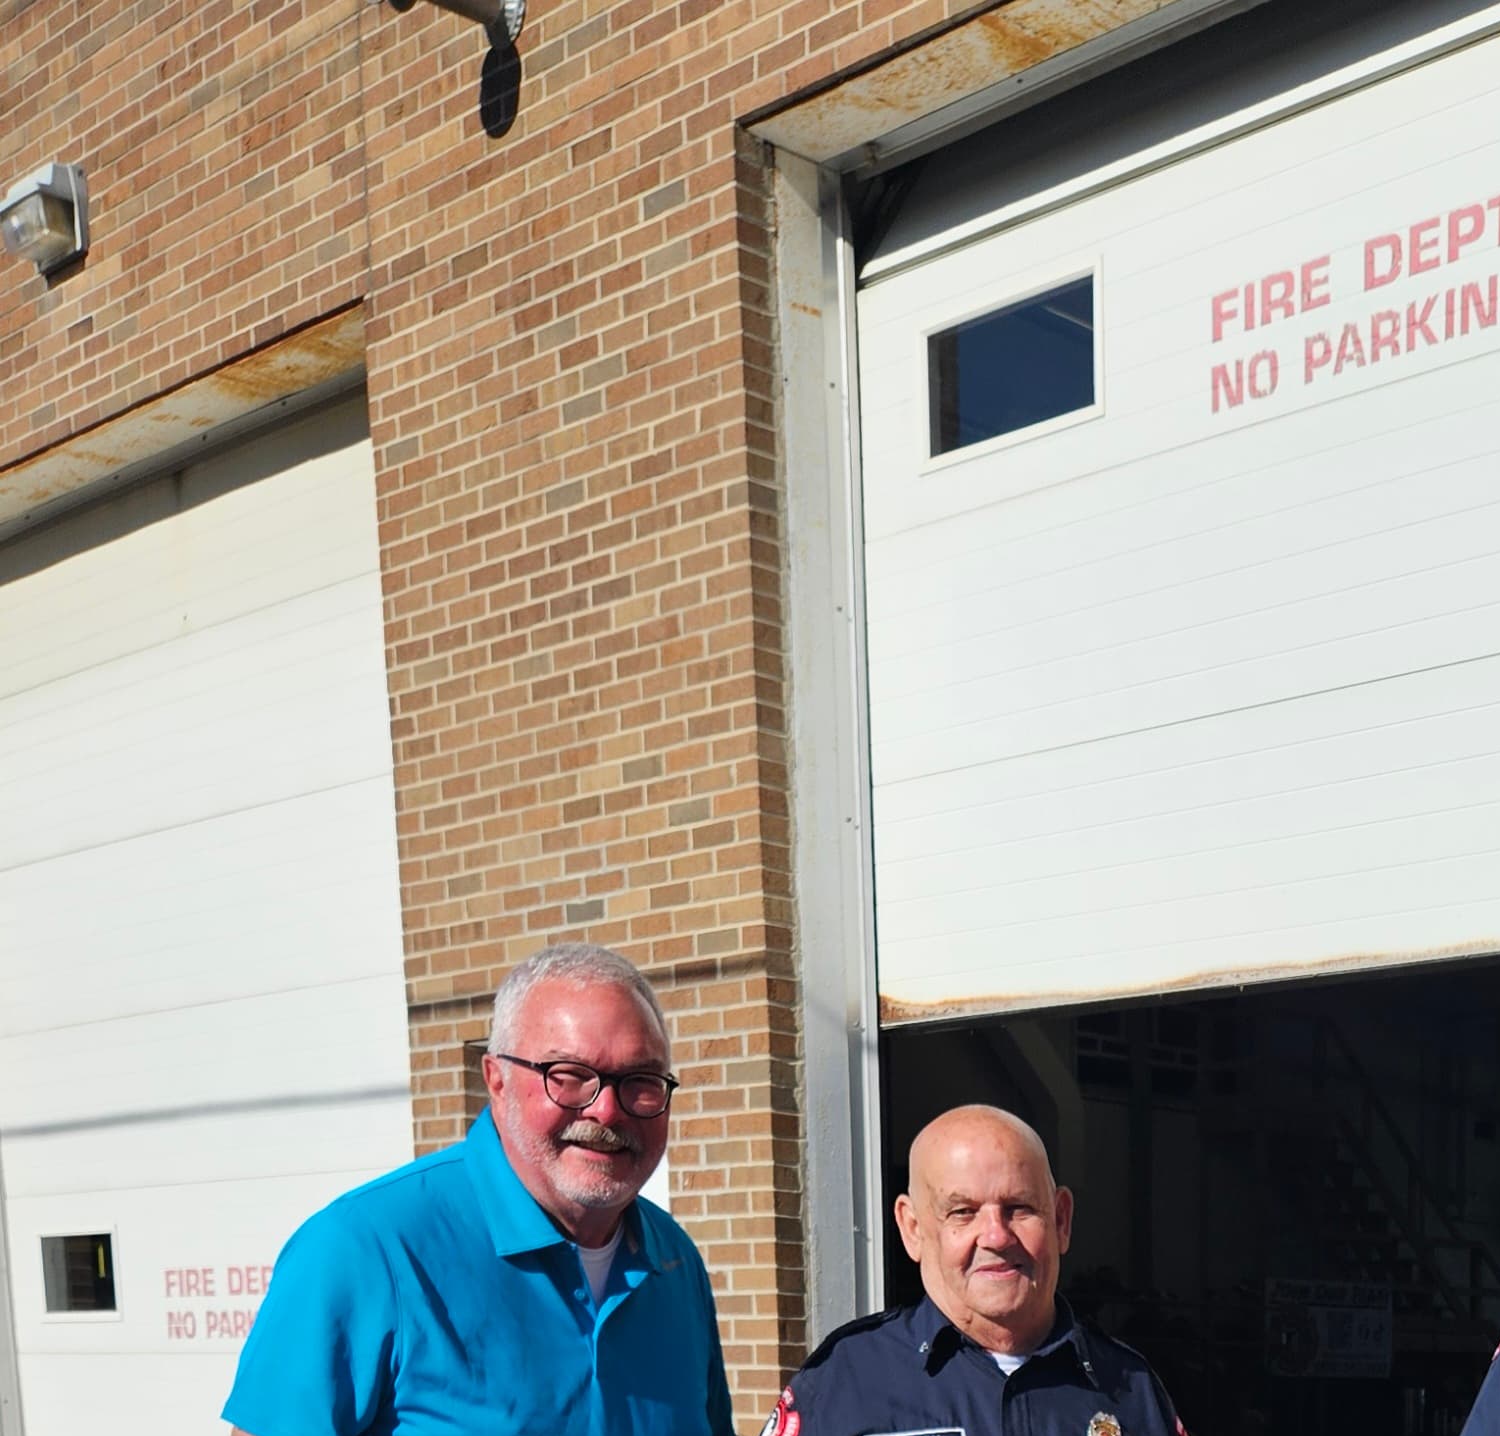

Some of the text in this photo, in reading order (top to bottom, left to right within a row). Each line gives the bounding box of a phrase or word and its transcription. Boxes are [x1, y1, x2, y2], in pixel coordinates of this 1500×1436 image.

[1211, 254, 1331, 344] FIRE
[1211, 349, 1279, 414] NO
[164, 1267, 215, 1298] FIRE
[166, 1310, 196, 1339] NO
